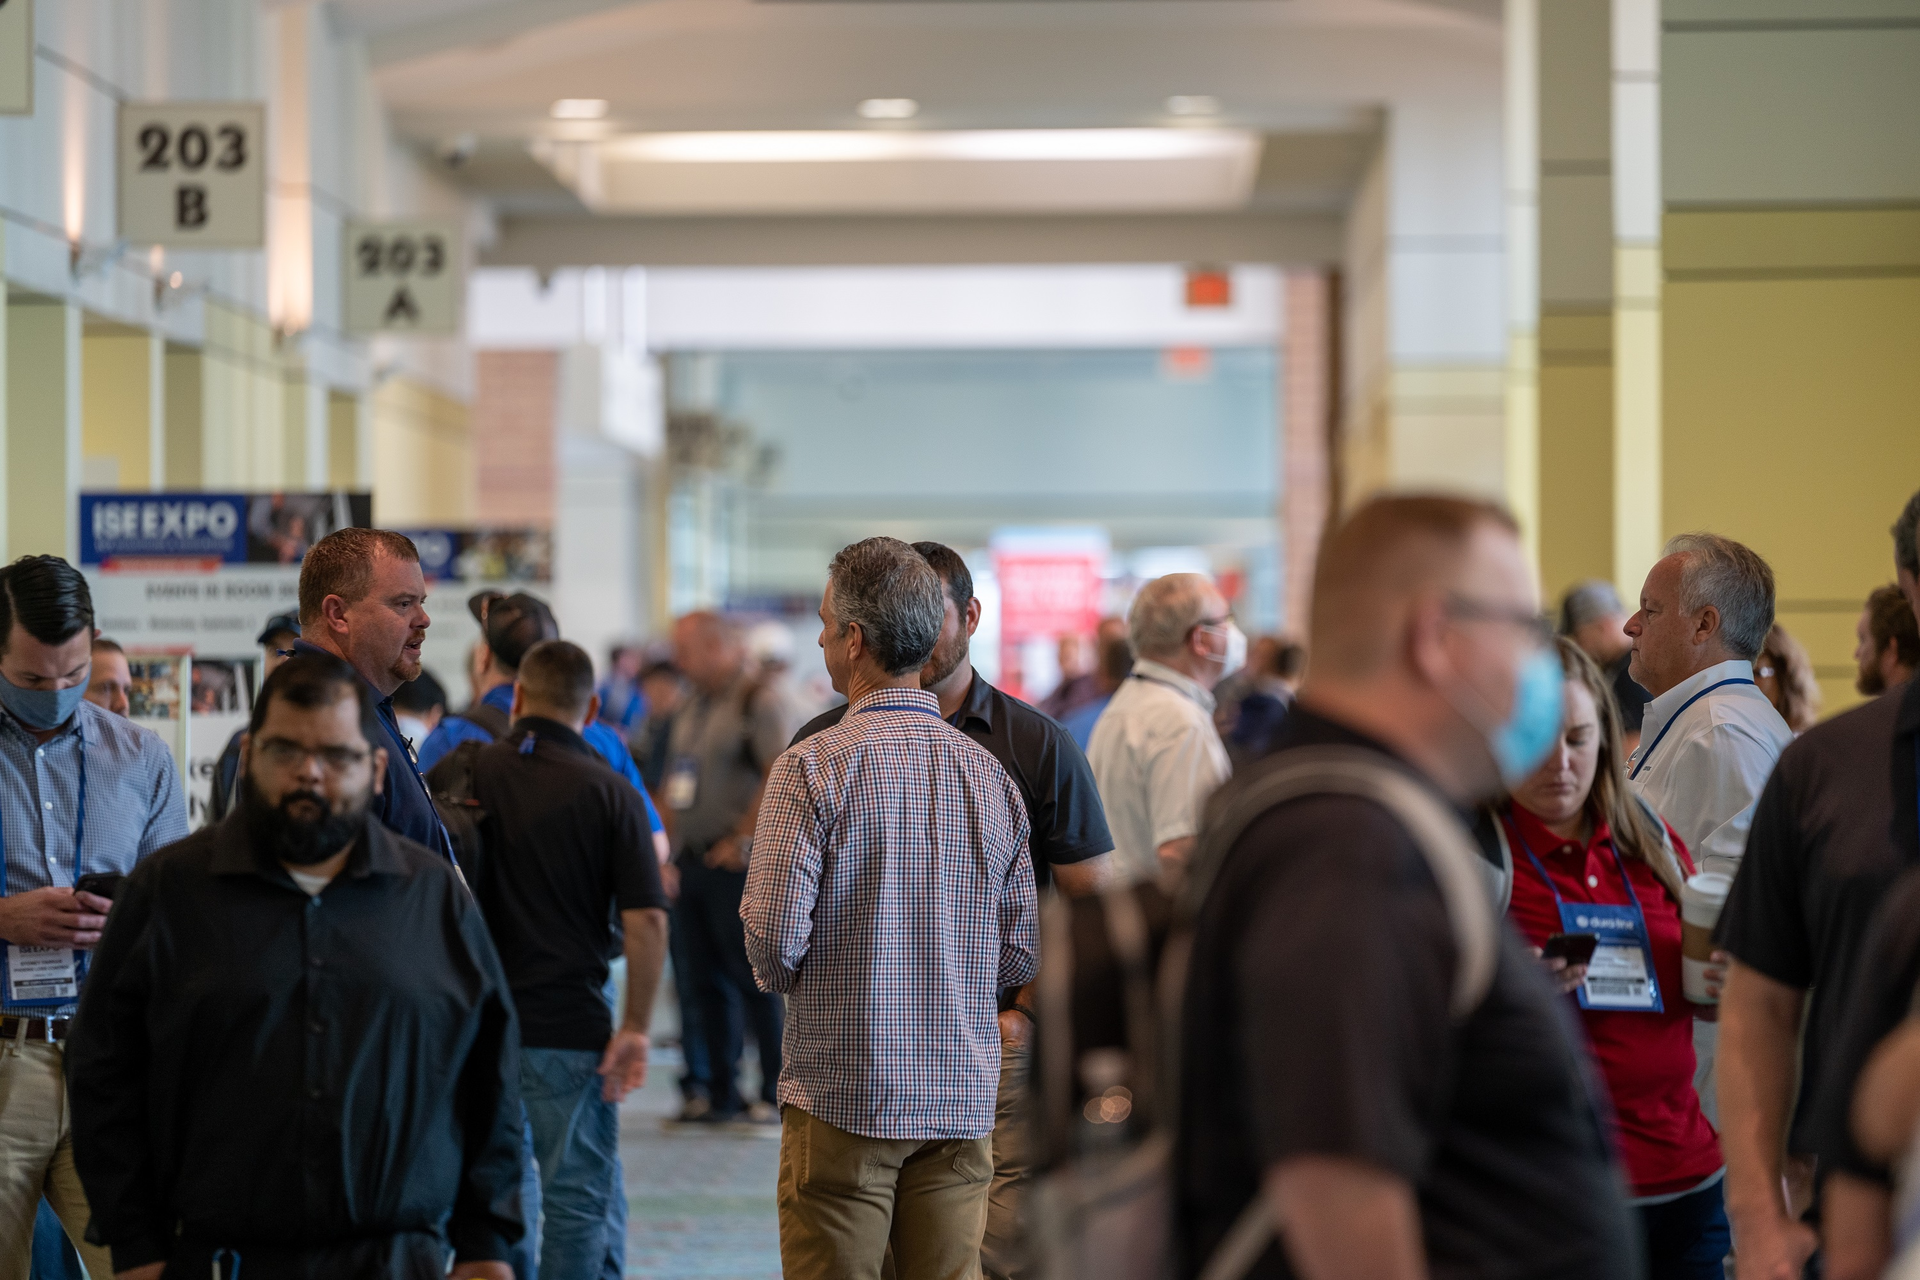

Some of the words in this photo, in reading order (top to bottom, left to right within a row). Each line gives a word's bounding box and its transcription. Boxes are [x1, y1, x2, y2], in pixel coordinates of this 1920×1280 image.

[137, 124, 249, 172] 203
[175, 186, 209, 231] B
[356, 235, 447, 277] 203
[385, 289, 419, 323] A
